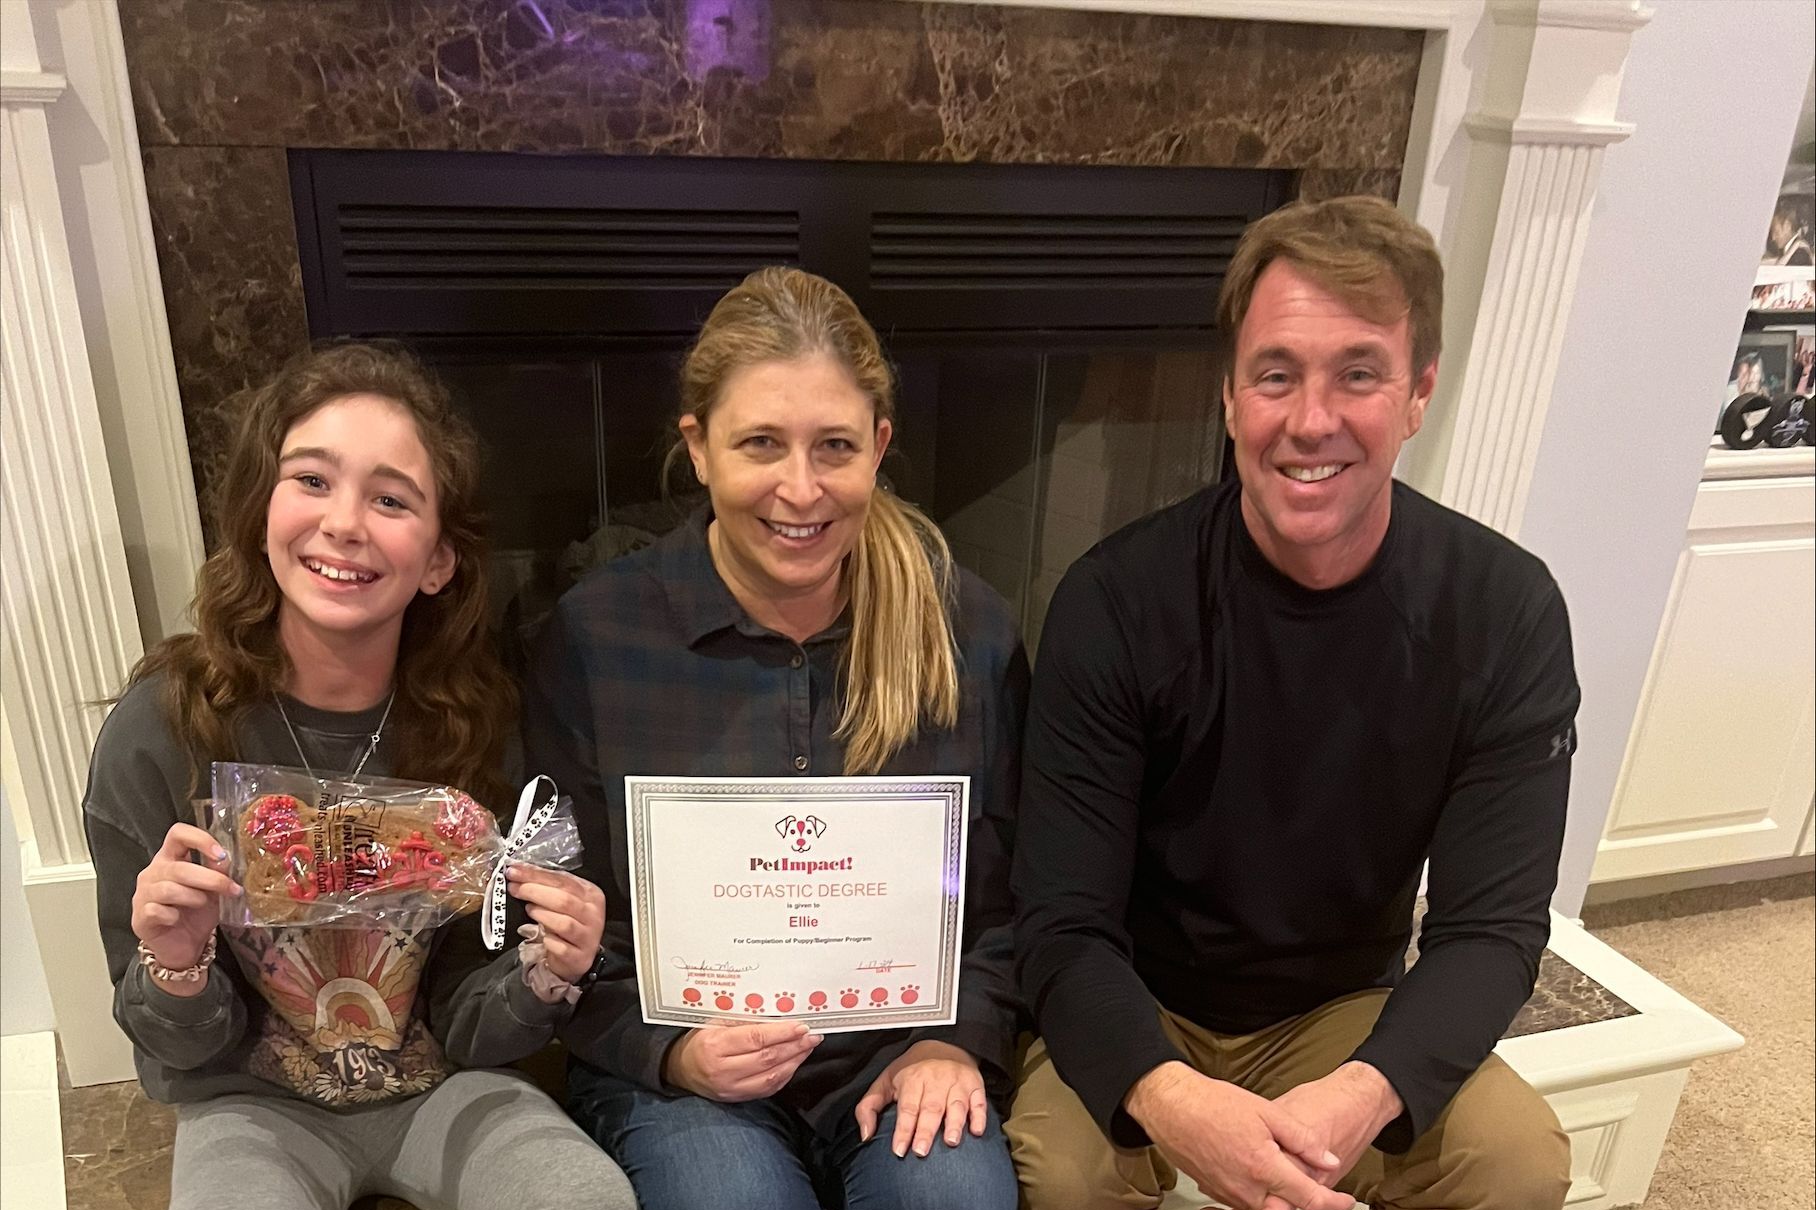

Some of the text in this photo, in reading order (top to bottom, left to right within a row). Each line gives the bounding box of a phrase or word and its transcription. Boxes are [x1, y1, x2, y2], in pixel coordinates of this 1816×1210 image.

[314, 793, 330, 893] treatsnleashed.com
[750, 857, 853, 874] PetImpact!
[713, 882, 888, 898] DOGTASTIC DEGREE
[789, 916, 818, 928] Ellie
